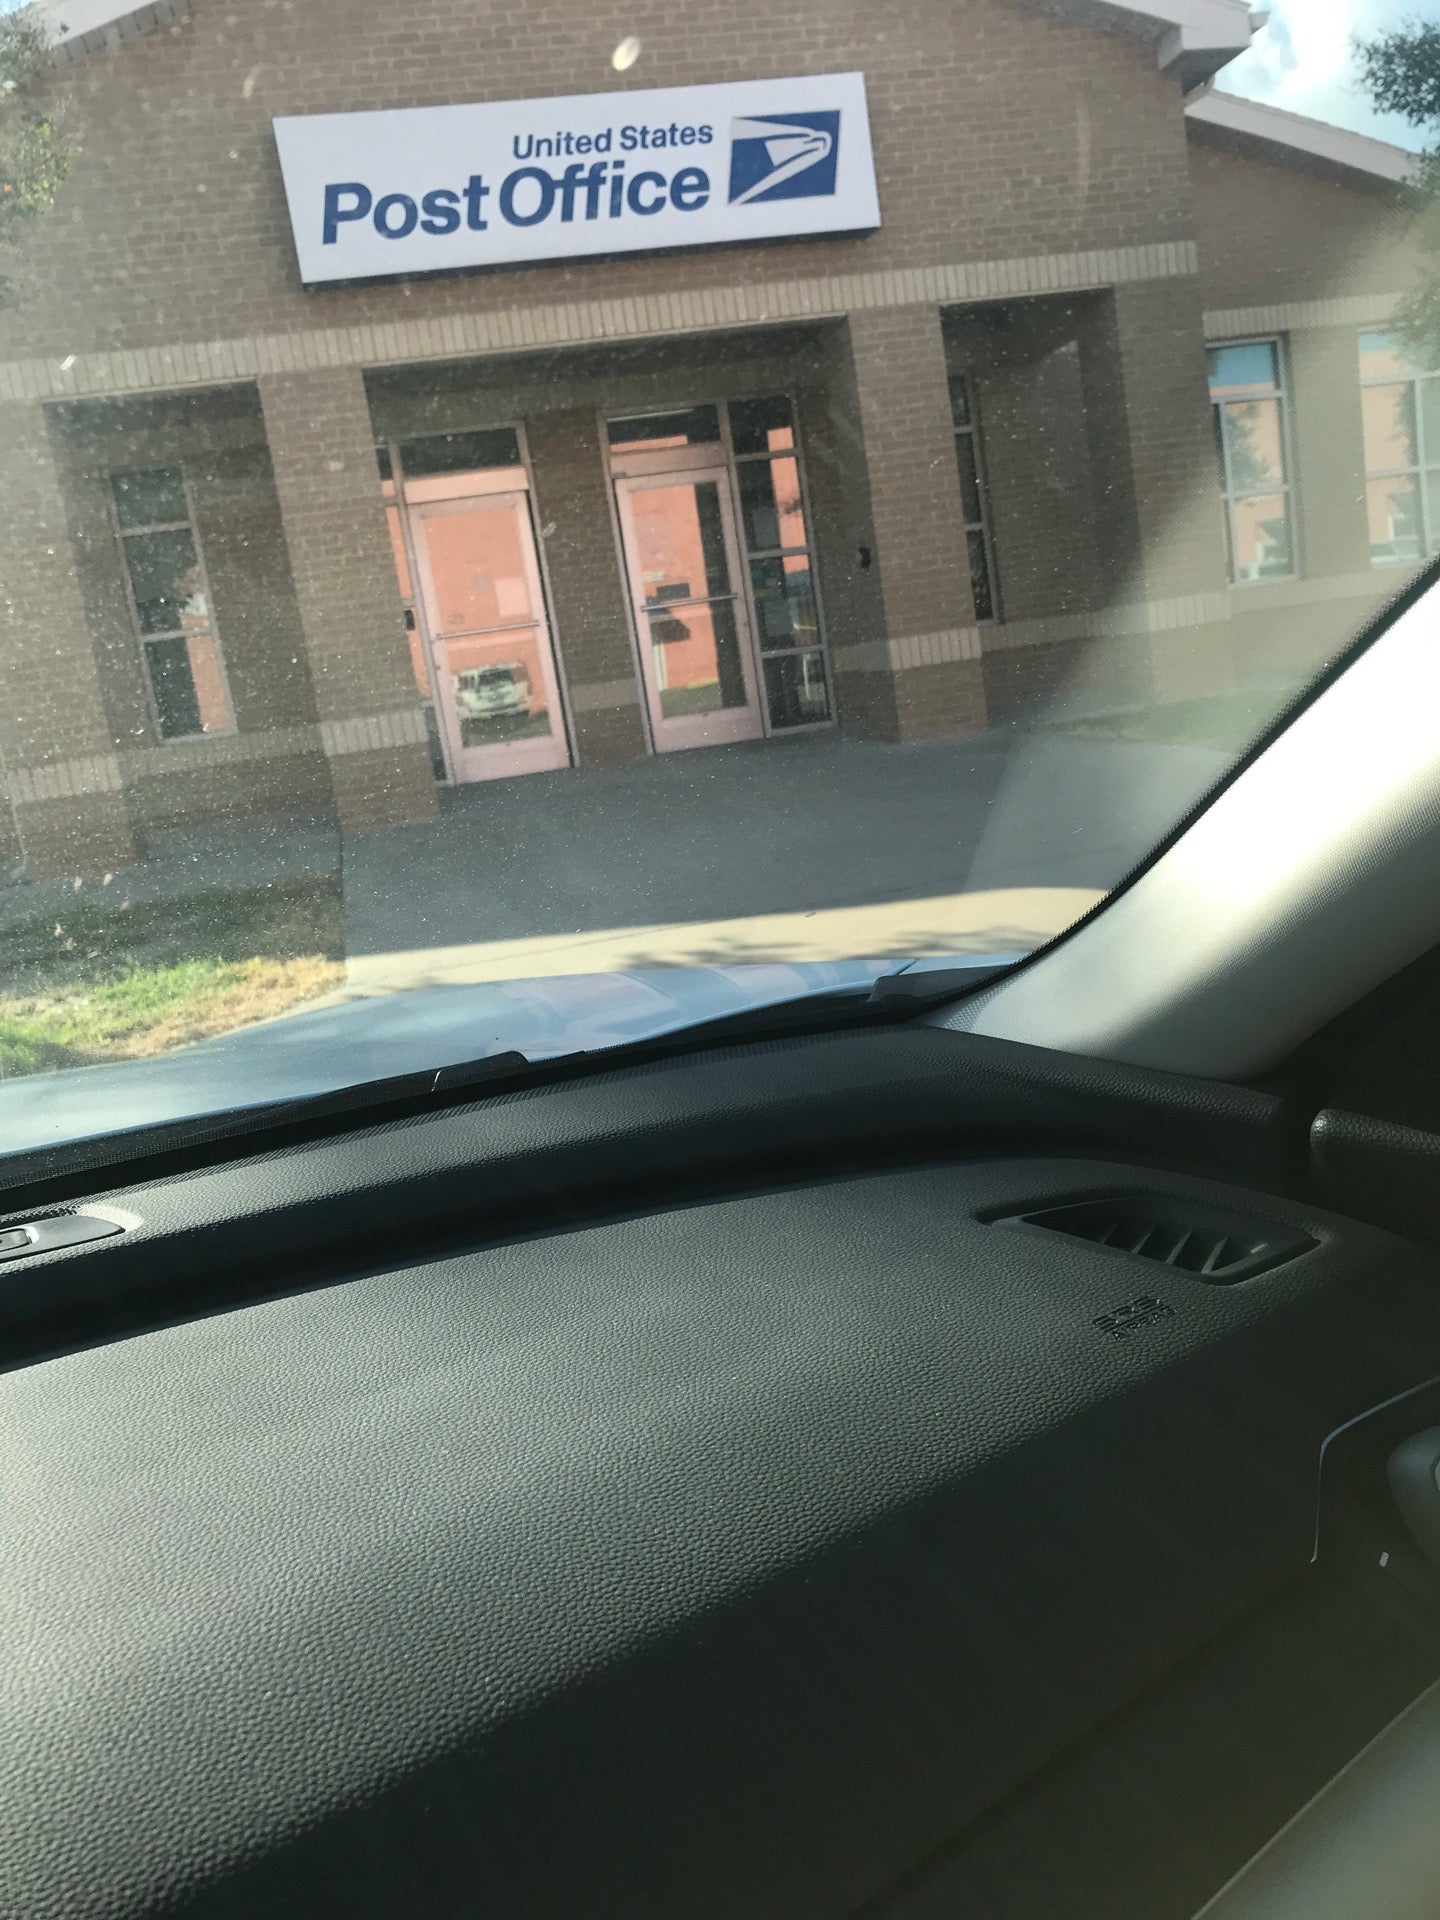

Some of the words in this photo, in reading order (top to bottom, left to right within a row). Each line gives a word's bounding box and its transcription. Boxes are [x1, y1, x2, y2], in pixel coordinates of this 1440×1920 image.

[512, 128, 612, 160] United
[619, 123, 714, 151] States
[322, 174, 489, 245] Post
[499, 159, 711, 228] Office
